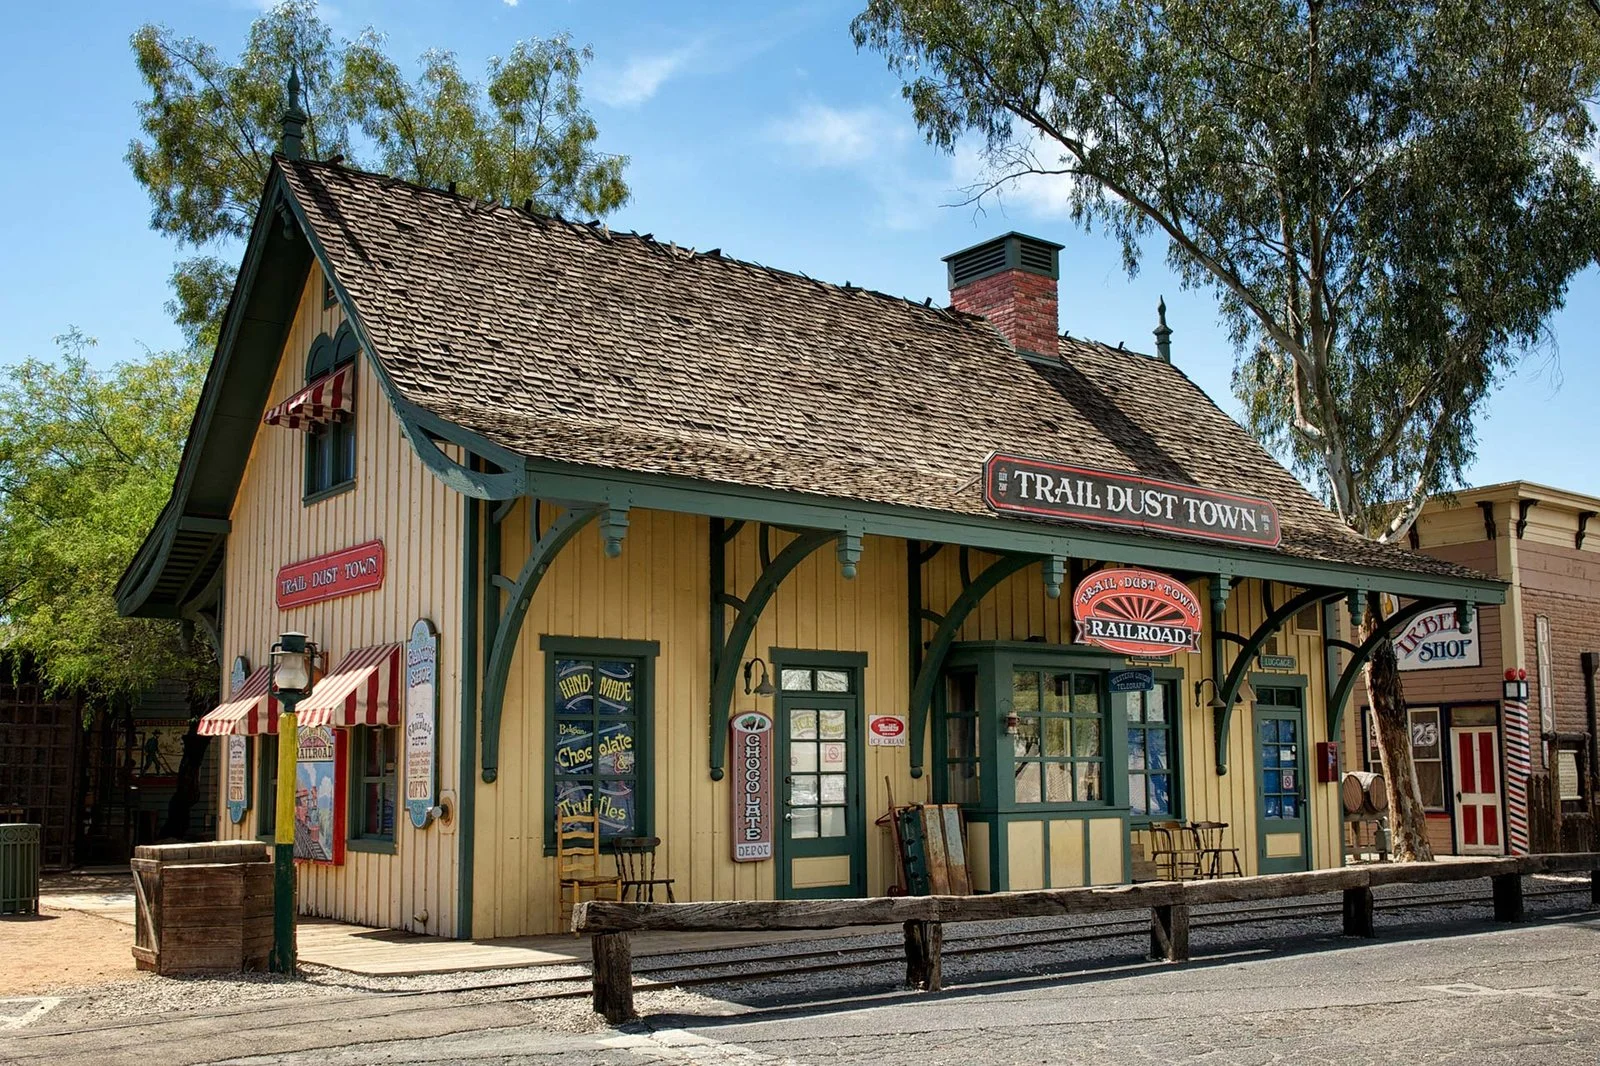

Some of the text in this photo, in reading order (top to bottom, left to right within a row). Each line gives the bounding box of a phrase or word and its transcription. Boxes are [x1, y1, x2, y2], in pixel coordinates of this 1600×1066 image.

[1013, 470, 1258, 532] TRAIL DUST TOWN
[281, 556, 377, 596] TRAIL DUST TOWN
[1080, 577, 1198, 617] TRAIL DUST TOWN
[1091, 620, 1187, 644] RAILROAD
[1419, 639, 1473, 662] SHOP
[1540, 621, 1552, 731] BATHS
[599, 676, 632, 702] MADE
[297, 746, 334, 759] AILROAD
[616, 754, 628, 770] &
[408, 780, 428, 798] GIFTS
[745, 734, 761, 841] CHOCOLATE
[738, 844, 769, 857] DEPOT
